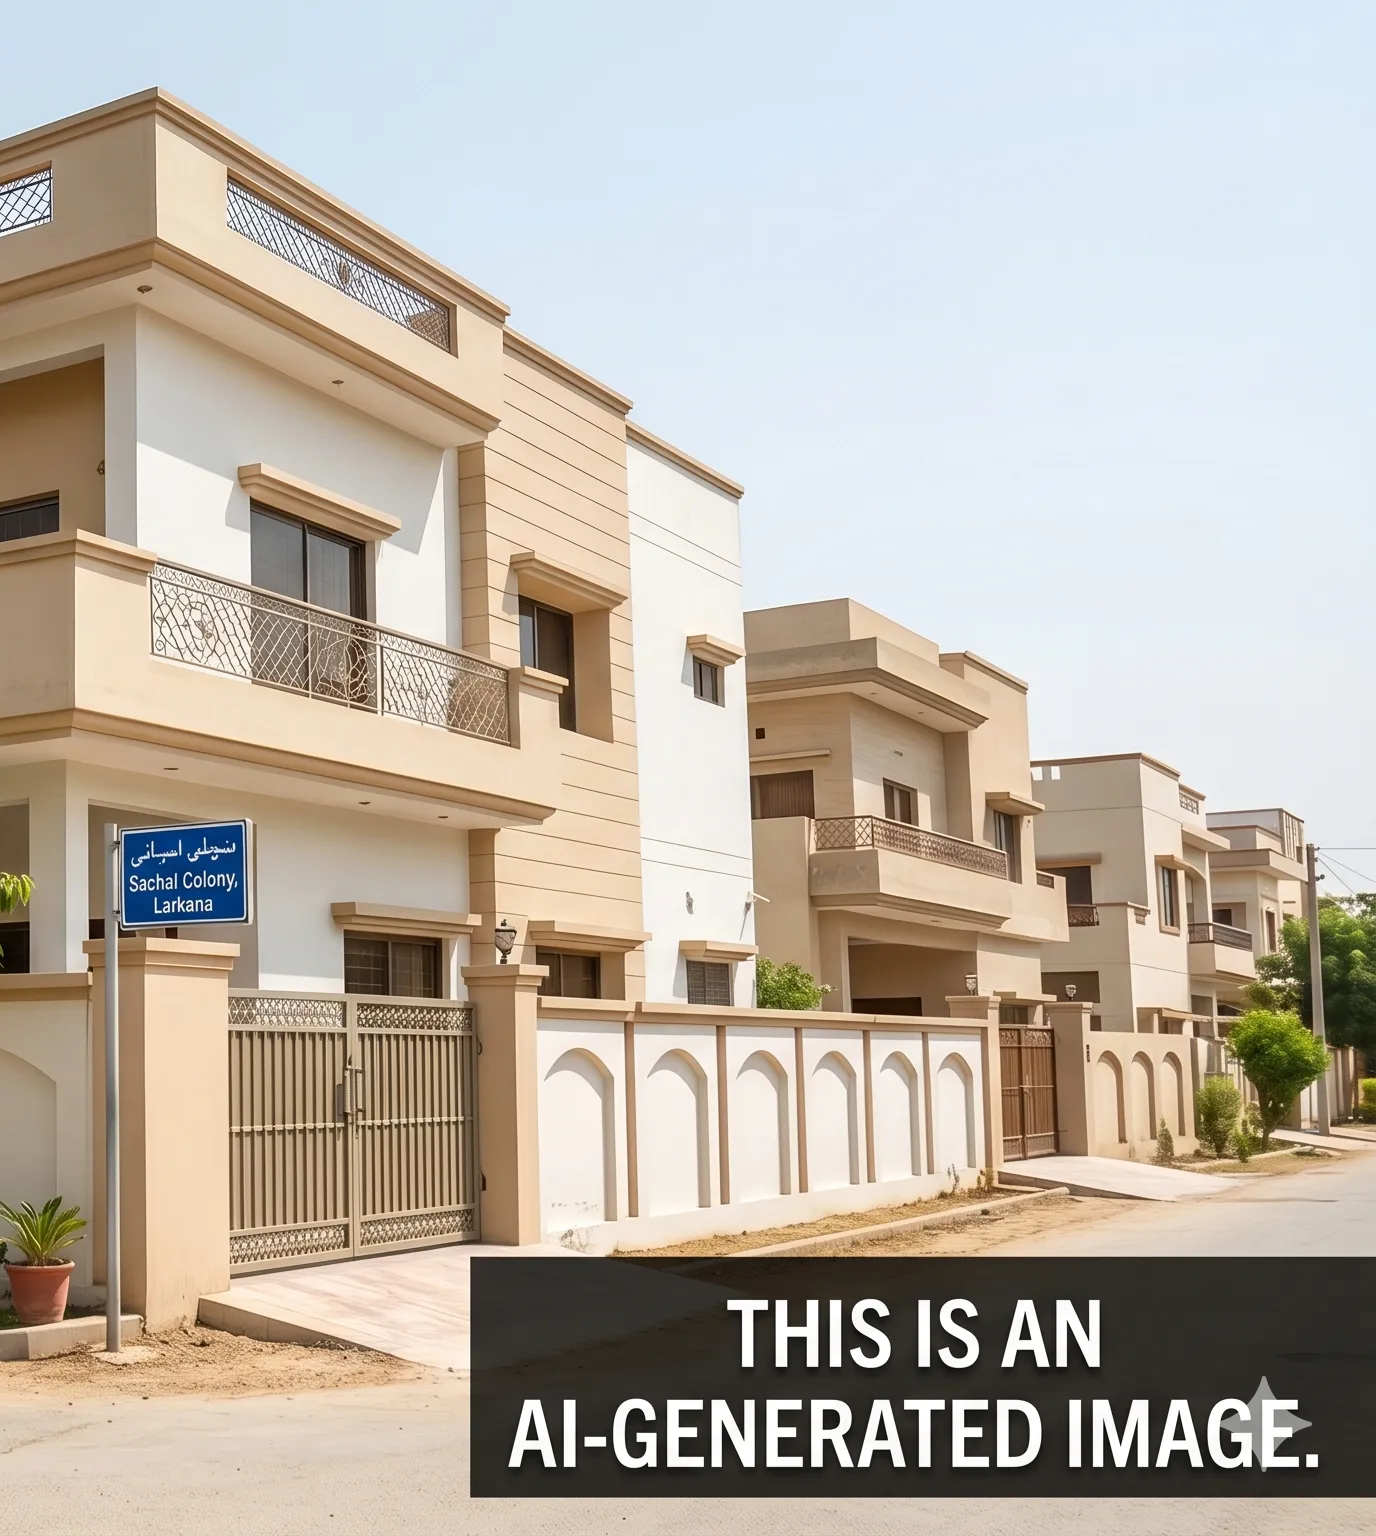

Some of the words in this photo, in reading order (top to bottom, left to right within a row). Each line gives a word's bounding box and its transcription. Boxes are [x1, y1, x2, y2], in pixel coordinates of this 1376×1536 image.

[129, 873, 177, 892] Sachal
[182, 870, 238, 892] Colony,
[154, 896, 213, 914] Larkana
